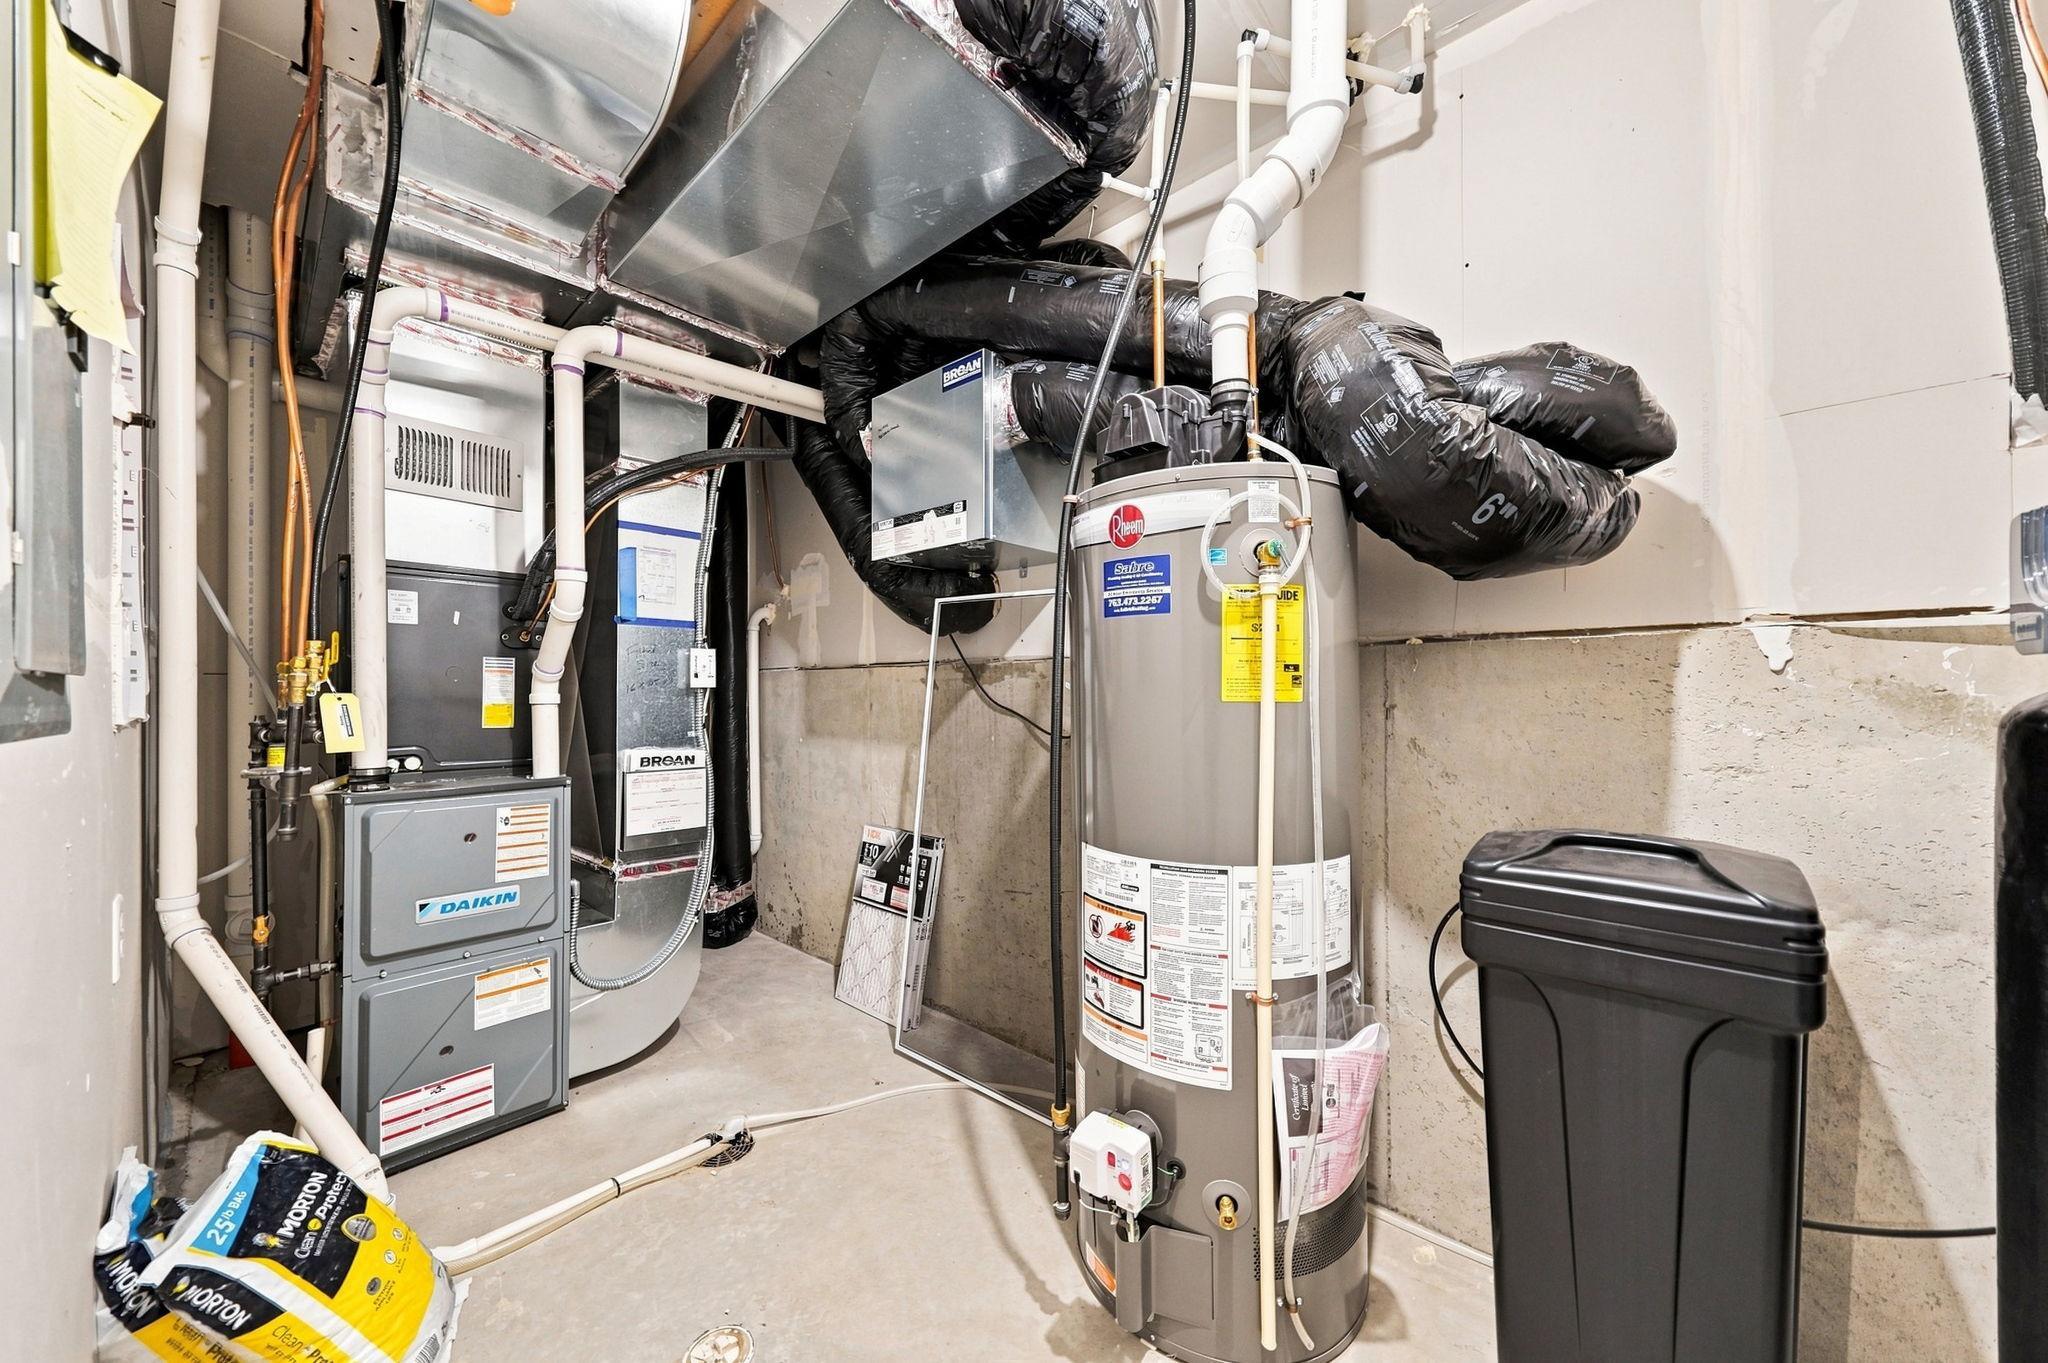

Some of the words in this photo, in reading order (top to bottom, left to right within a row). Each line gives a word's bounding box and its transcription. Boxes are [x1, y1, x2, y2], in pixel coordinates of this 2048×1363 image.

[943, 357, 982, 383] BROAN
[1112, 507, 1144, 543] Rheem
[1114, 561, 1155, 575] Sabre
[640, 755, 696, 768] BROAN
[869, 844, 879, 860] 10
[440, 891, 518, 914] DAIKIN
[227, 1191, 247, 1211] BAG
[276, 1172, 328, 1239] MORTON
[175, 1285, 251, 1331] MORTON
[272, 1325, 304, 1356] Clean
